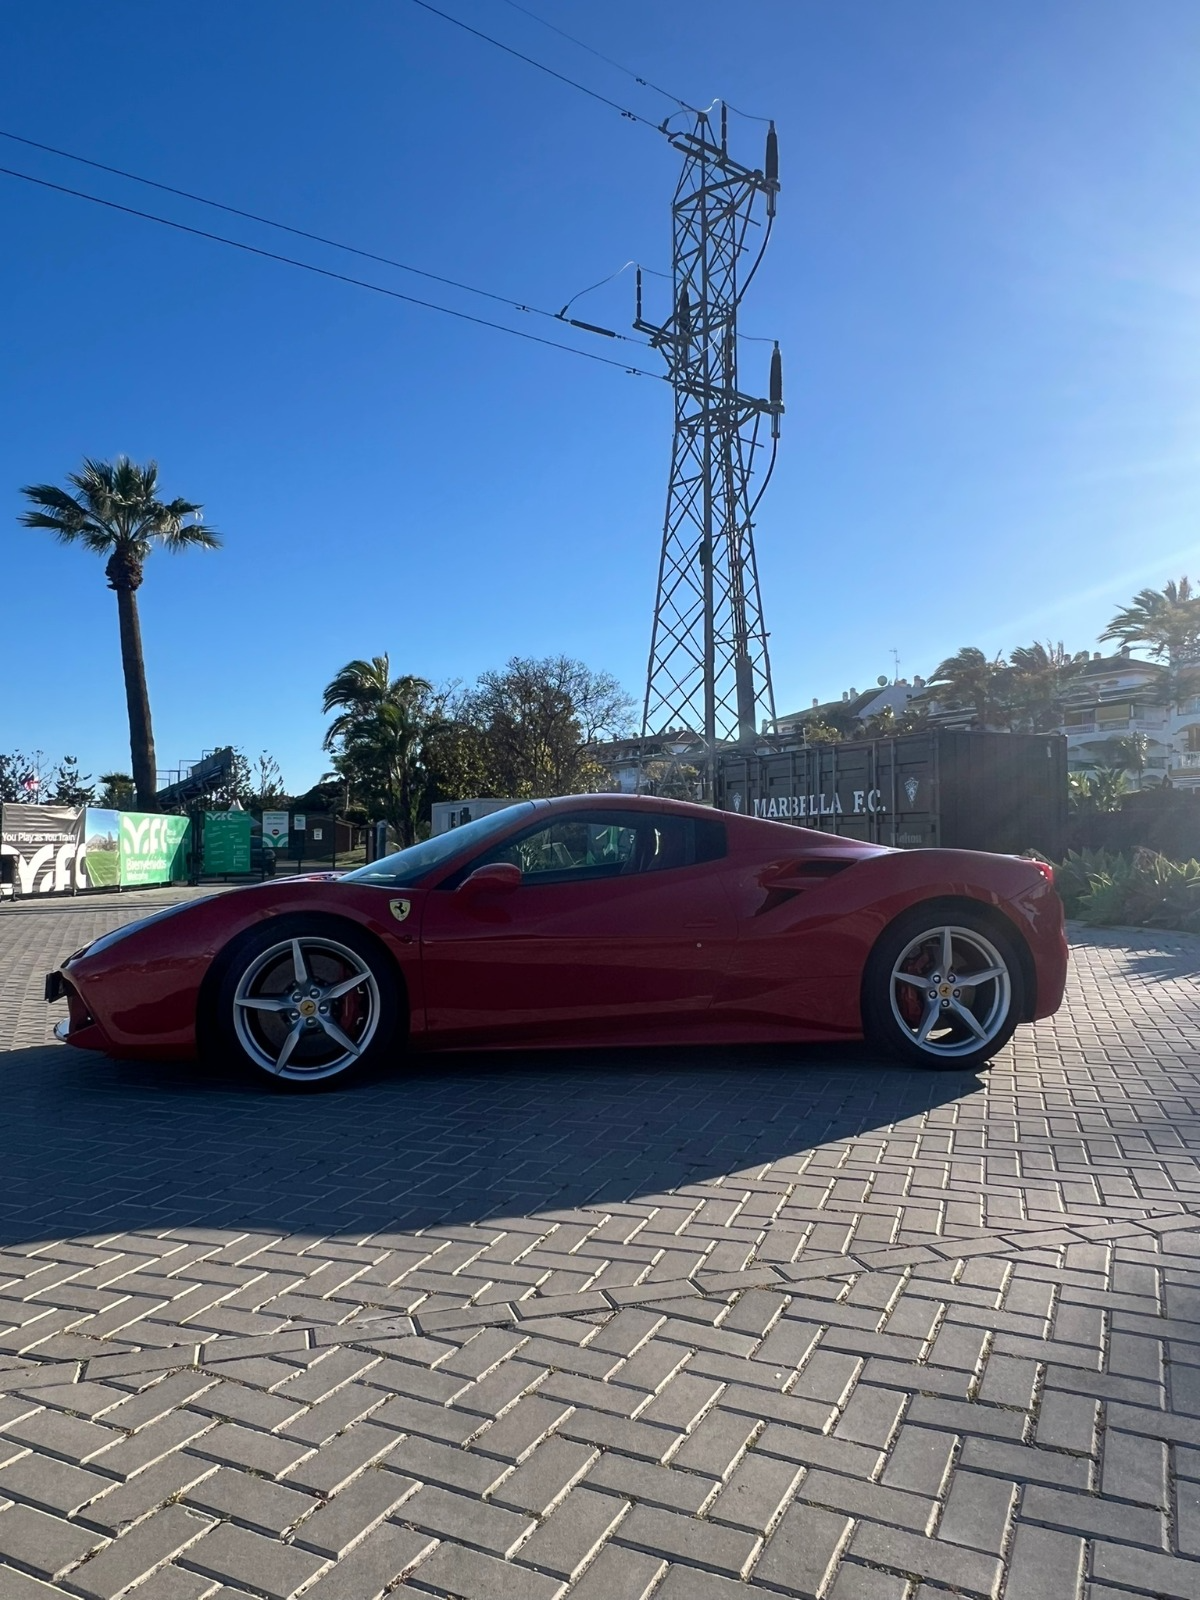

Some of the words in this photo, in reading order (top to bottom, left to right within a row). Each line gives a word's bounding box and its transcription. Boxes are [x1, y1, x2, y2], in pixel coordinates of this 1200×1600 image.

[753, 792, 843, 819] MARBELLA
[853, 789, 886, 813] F.C.
[2, 832, 17, 842] You
[18, 832, 33, 844] Play
[34, 834, 44, 842] as
[44, 833, 58, 842] You
[58, 832, 76, 842] Train
[126, 857, 167, 871] Bienvenidos
